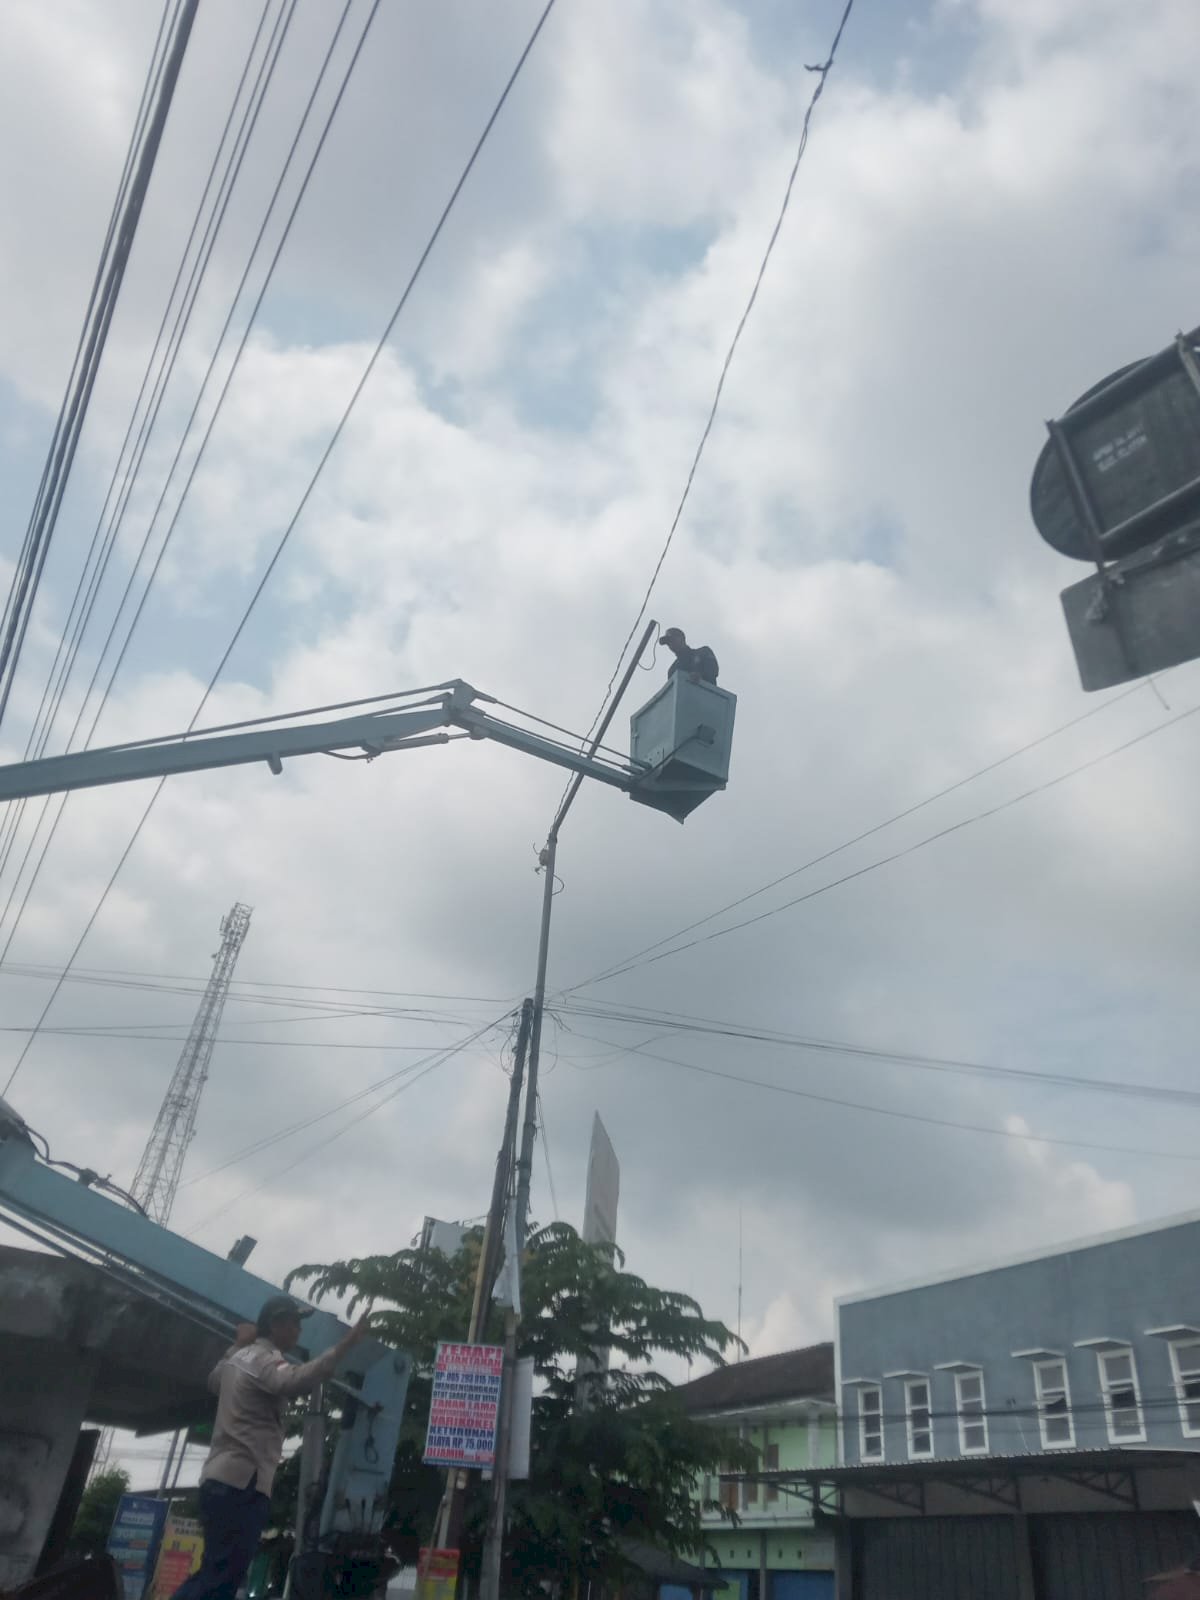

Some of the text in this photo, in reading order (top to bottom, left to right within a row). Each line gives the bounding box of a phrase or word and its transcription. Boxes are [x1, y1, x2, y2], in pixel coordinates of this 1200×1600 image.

[441, 1344, 502, 1358] TERAPI
[438, 1355, 501, 1369] KEJANTANAN
[433, 1399, 497, 1410] TAHAN LAMA
[431, 1416, 495, 1429] VARIKOKEL
[429, 1426, 494, 1438] KETURUNAN
[428, 1435, 451, 1448] BIAYA
[465, 1438, 493, 1450] 75.000
